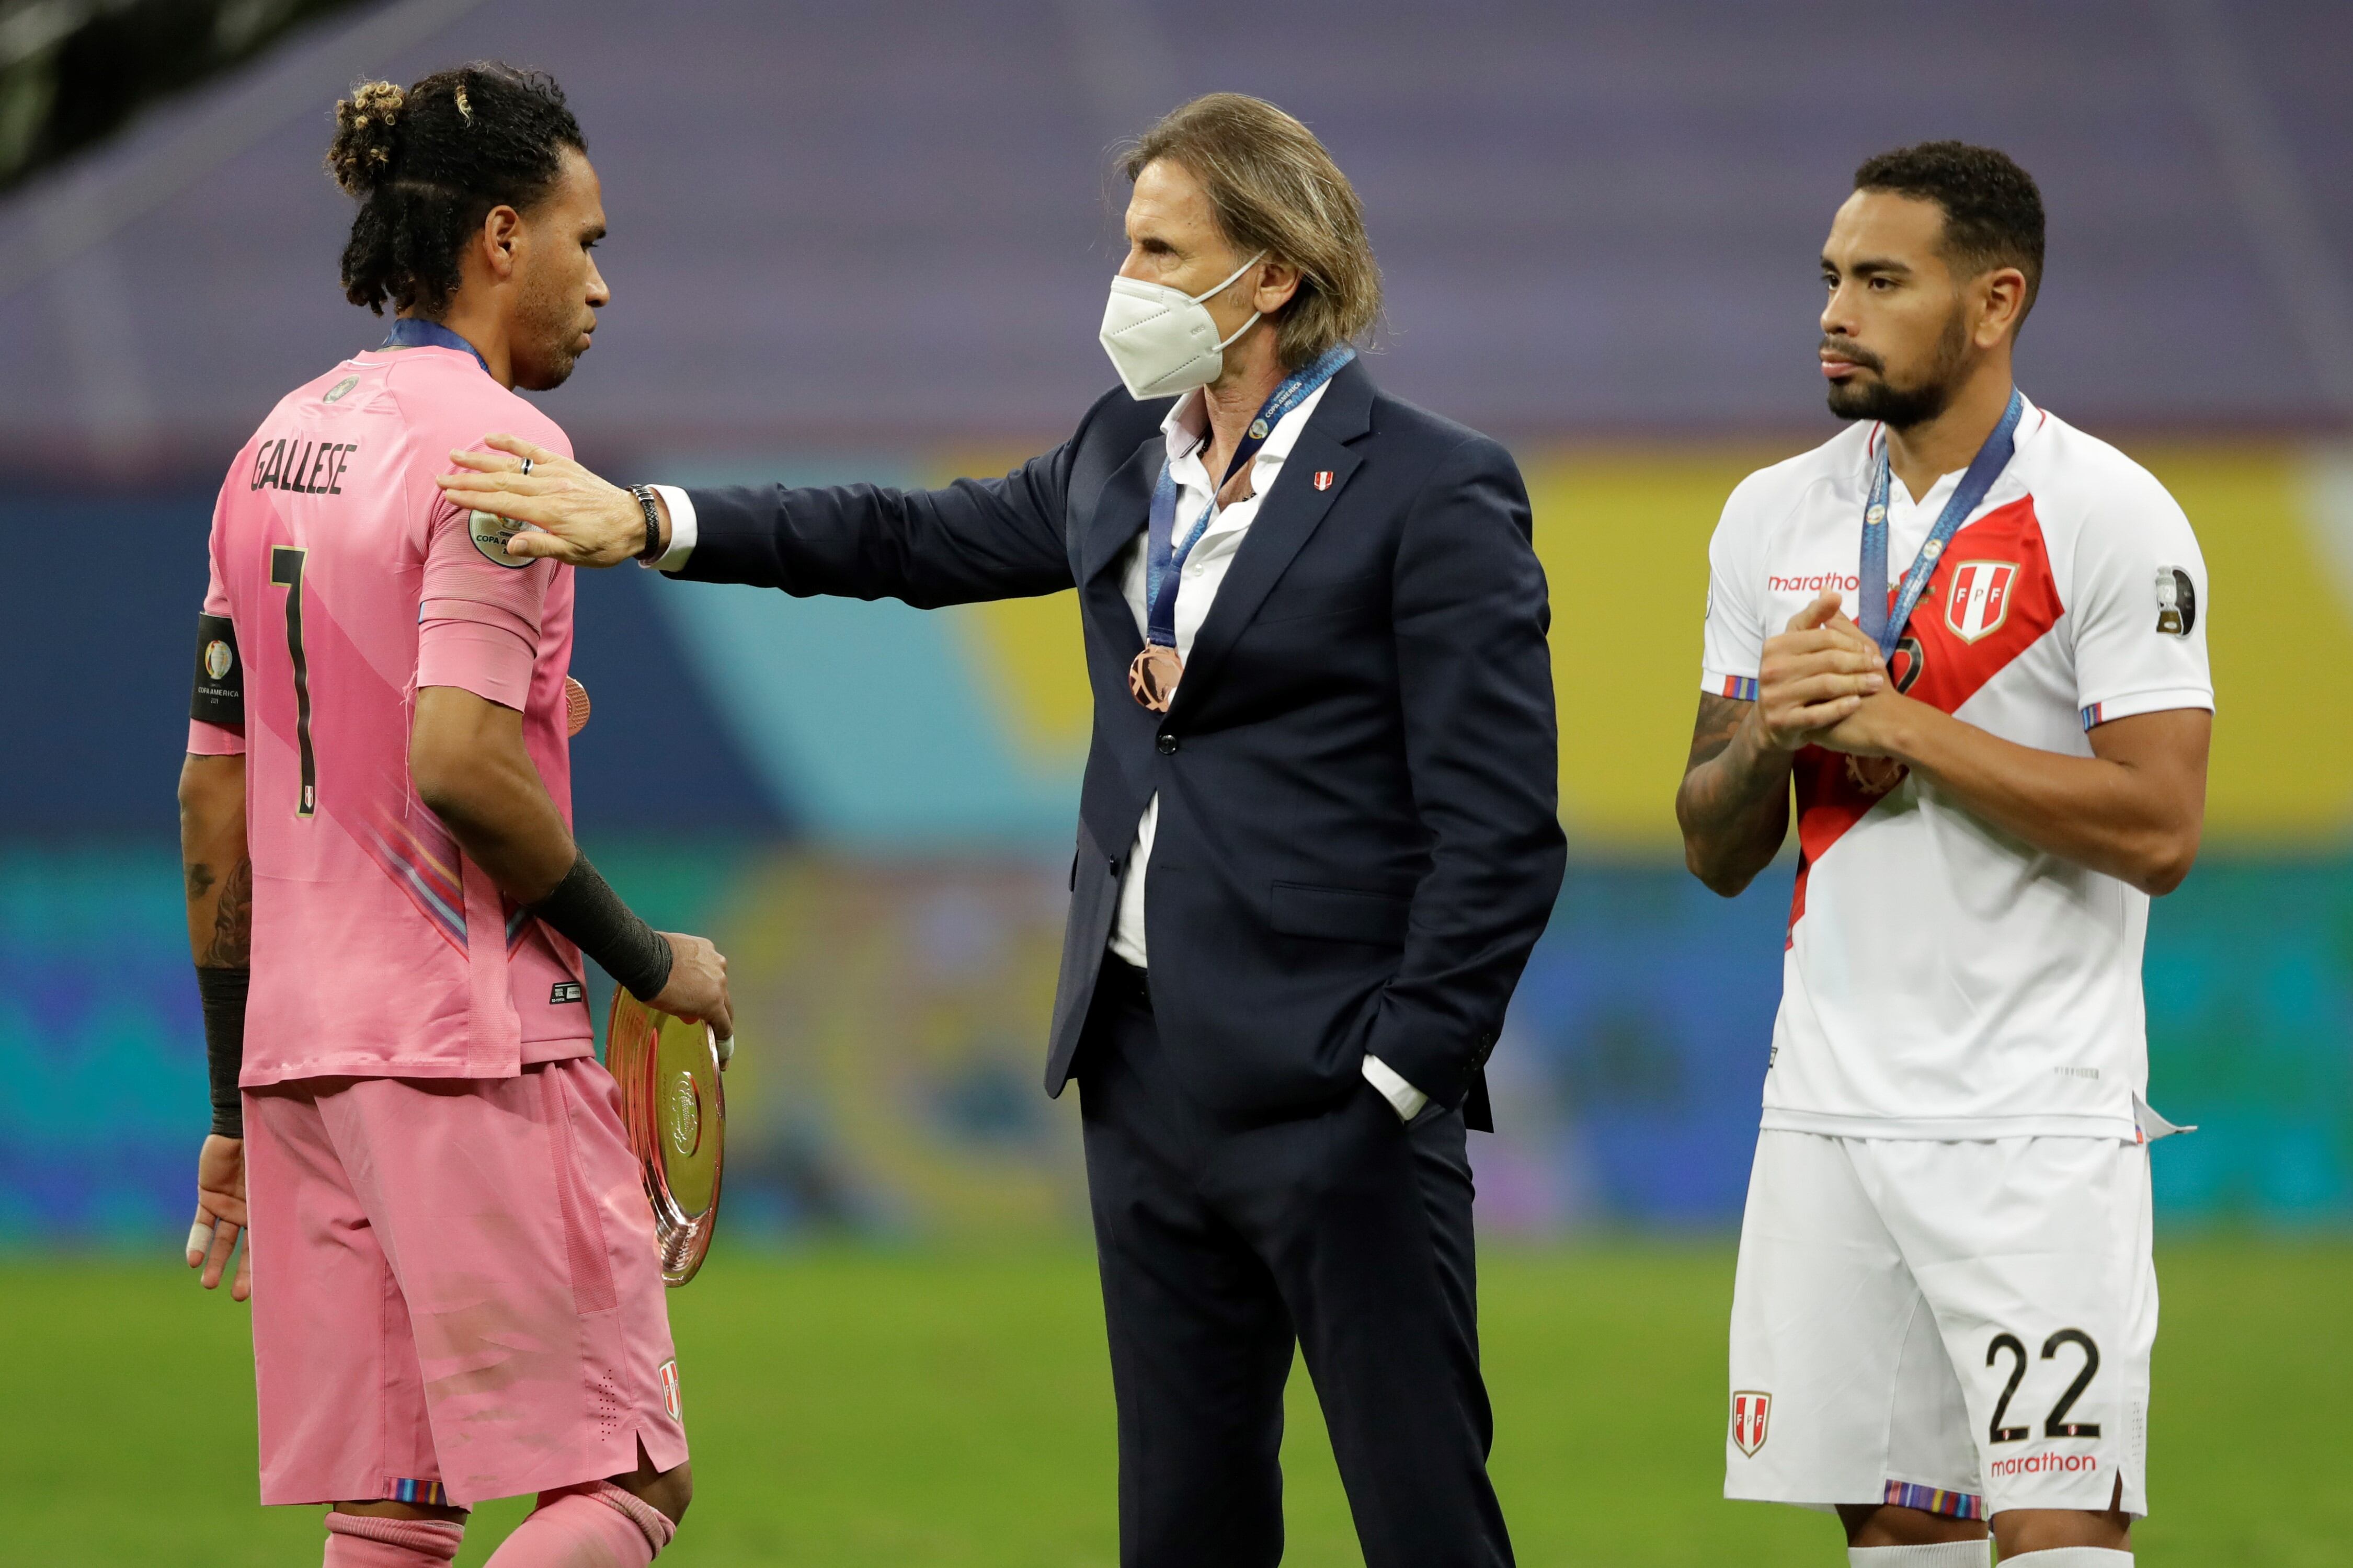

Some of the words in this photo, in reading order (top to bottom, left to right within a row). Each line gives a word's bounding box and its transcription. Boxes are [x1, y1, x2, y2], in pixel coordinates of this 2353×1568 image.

[1265, 403, 1280, 418] COPA
[1278, 382, 1302, 405] AMERICA
[251, 439, 358, 495] GALLESE
[476, 534, 499, 544] COPA
[1768, 572, 1860, 591] maratho
[1986, 1326, 2101, 1445] 22
[1991, 1451, 2096, 1478] marathon
